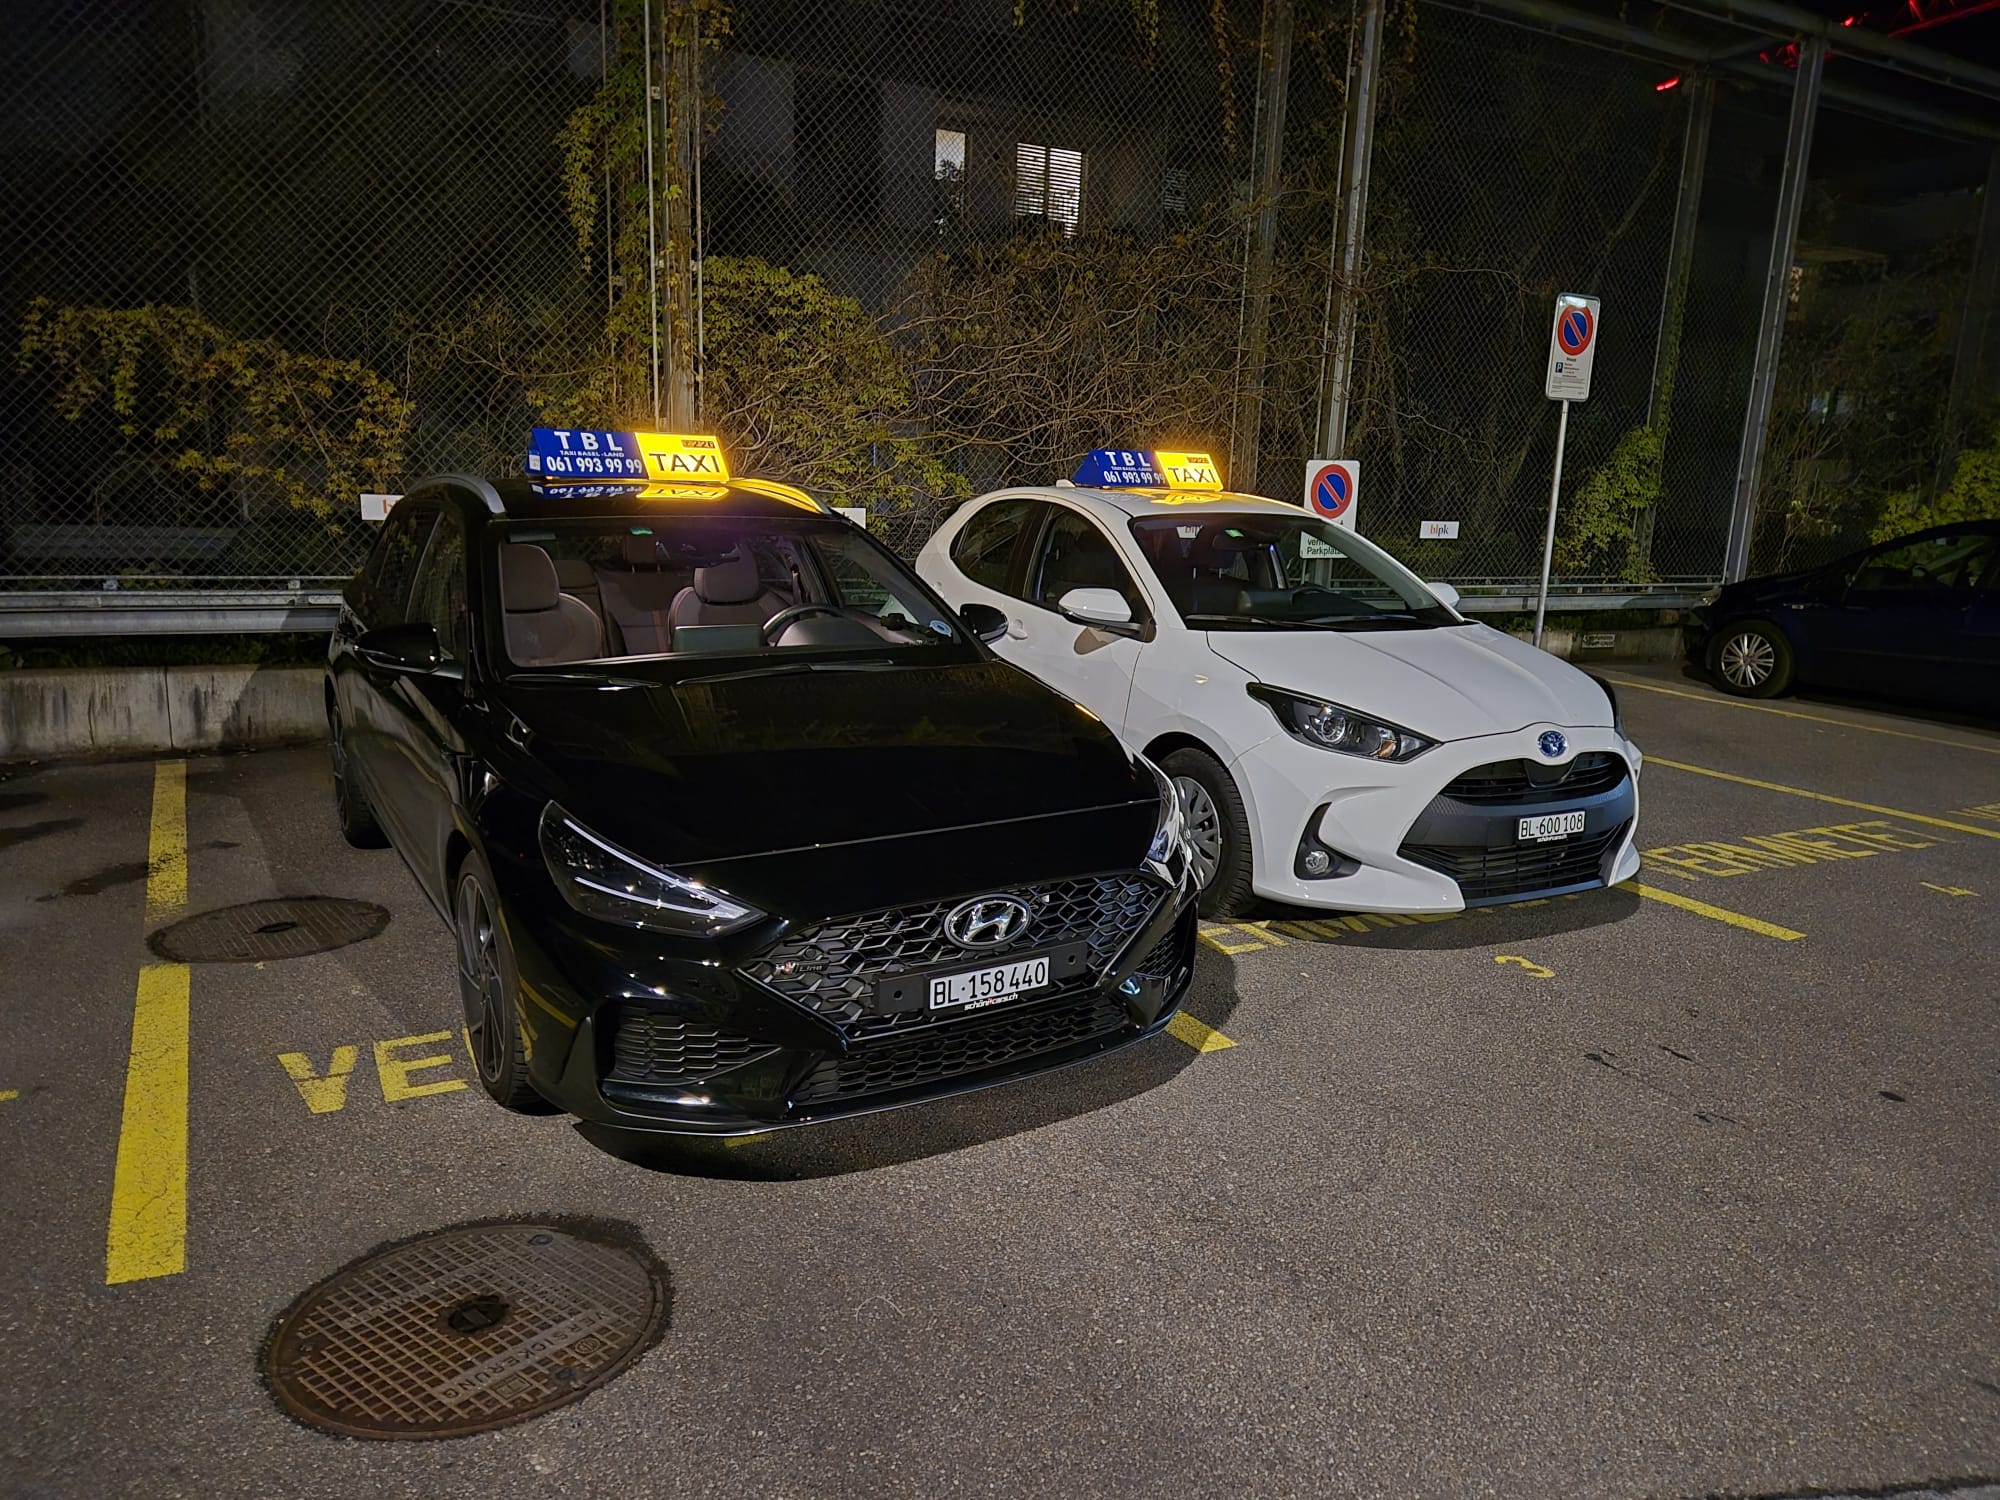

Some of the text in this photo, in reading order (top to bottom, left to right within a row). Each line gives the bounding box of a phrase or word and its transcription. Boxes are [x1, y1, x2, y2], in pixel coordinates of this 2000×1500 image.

[546, 456, 573, 472] 061
[576, 457, 604, 473] 993
[605, 458, 623, 473] 99
[625, 458, 643, 474] 99
[648, 453, 721, 473] TAXI
[1103, 470, 1166, 485] 061 993 99 99
[1168, 467, 1216, 484] TAXI
[1430, 523, 1449, 537] blpk
[1494, 955, 1556, 978] 3
[277, 1027, 479, 1115] VE
[443, 1310, 618, 1401] VERSICKERUNG
